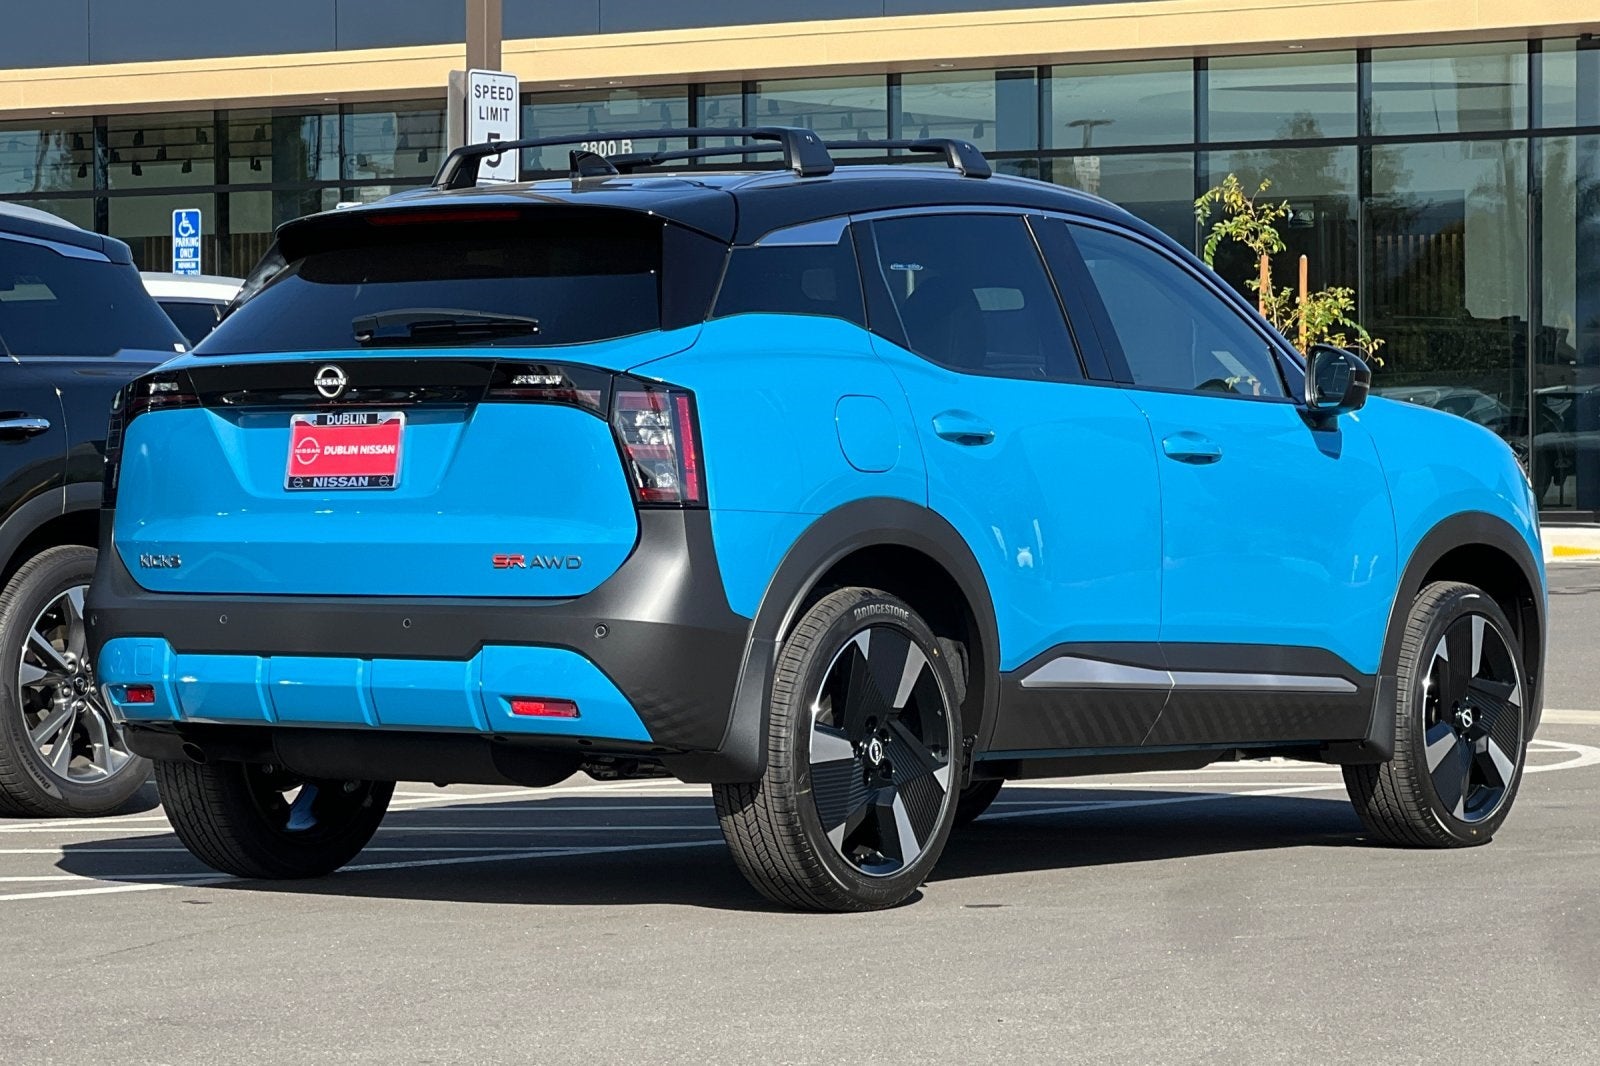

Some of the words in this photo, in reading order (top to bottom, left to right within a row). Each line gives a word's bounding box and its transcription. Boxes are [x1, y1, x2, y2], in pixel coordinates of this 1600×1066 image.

[474, 84, 514, 101] SPEED
[479, 106, 510, 122] LIMIT
[485, 132, 502, 168] 5
[580, 139, 617, 157] 3800
[621, 138, 633, 155] B
[176, 237, 199, 247] PARKING
[180, 248, 194, 258] ONLY
[314, 378, 347, 386] NISSAN
[326, 414, 368, 425] DUBLIN
[323, 445, 359, 456] DUBLIN
[359, 445, 396, 455] NISSAN
[313, 476, 369, 488] NISSAN
[140, 553, 182, 568] KICKS
[492, 554, 527, 569] SR
[529, 554, 583, 570] AWD
[853, 603, 910, 622] BRIDGESTONE
